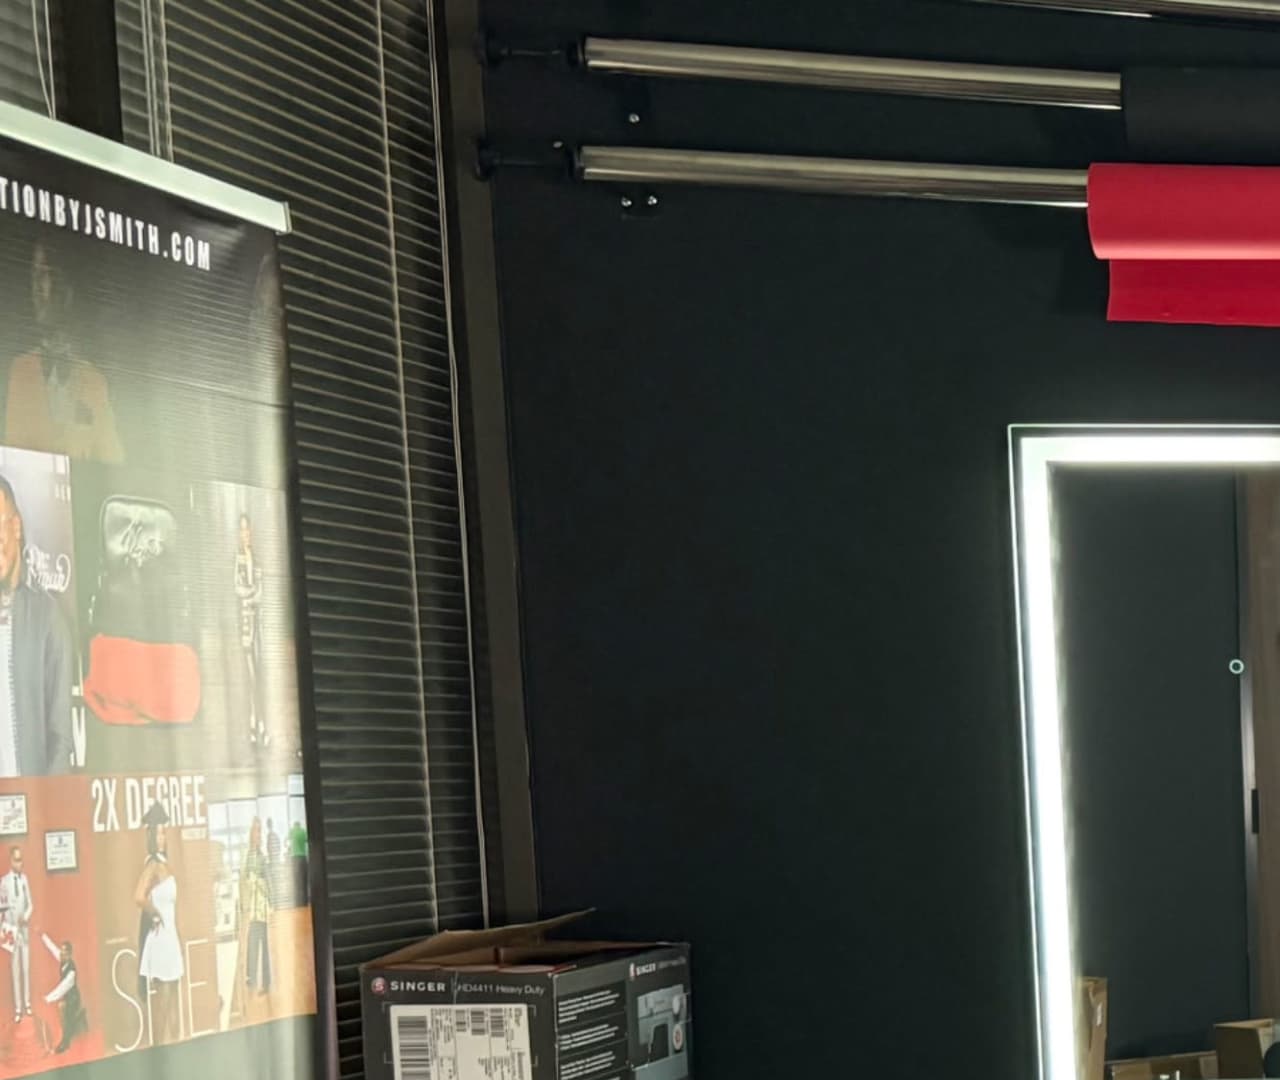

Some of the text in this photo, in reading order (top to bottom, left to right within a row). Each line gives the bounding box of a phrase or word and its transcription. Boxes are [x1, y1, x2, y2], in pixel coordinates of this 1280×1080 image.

[0, 176, 210, 270] TIONBYJSMITH.COM
[92, 778, 120, 832] 2X
[390, 981, 446, 992] SINGER
[496, 983, 523, 996] Heavy
[524, 984, 545, 997] Duty
